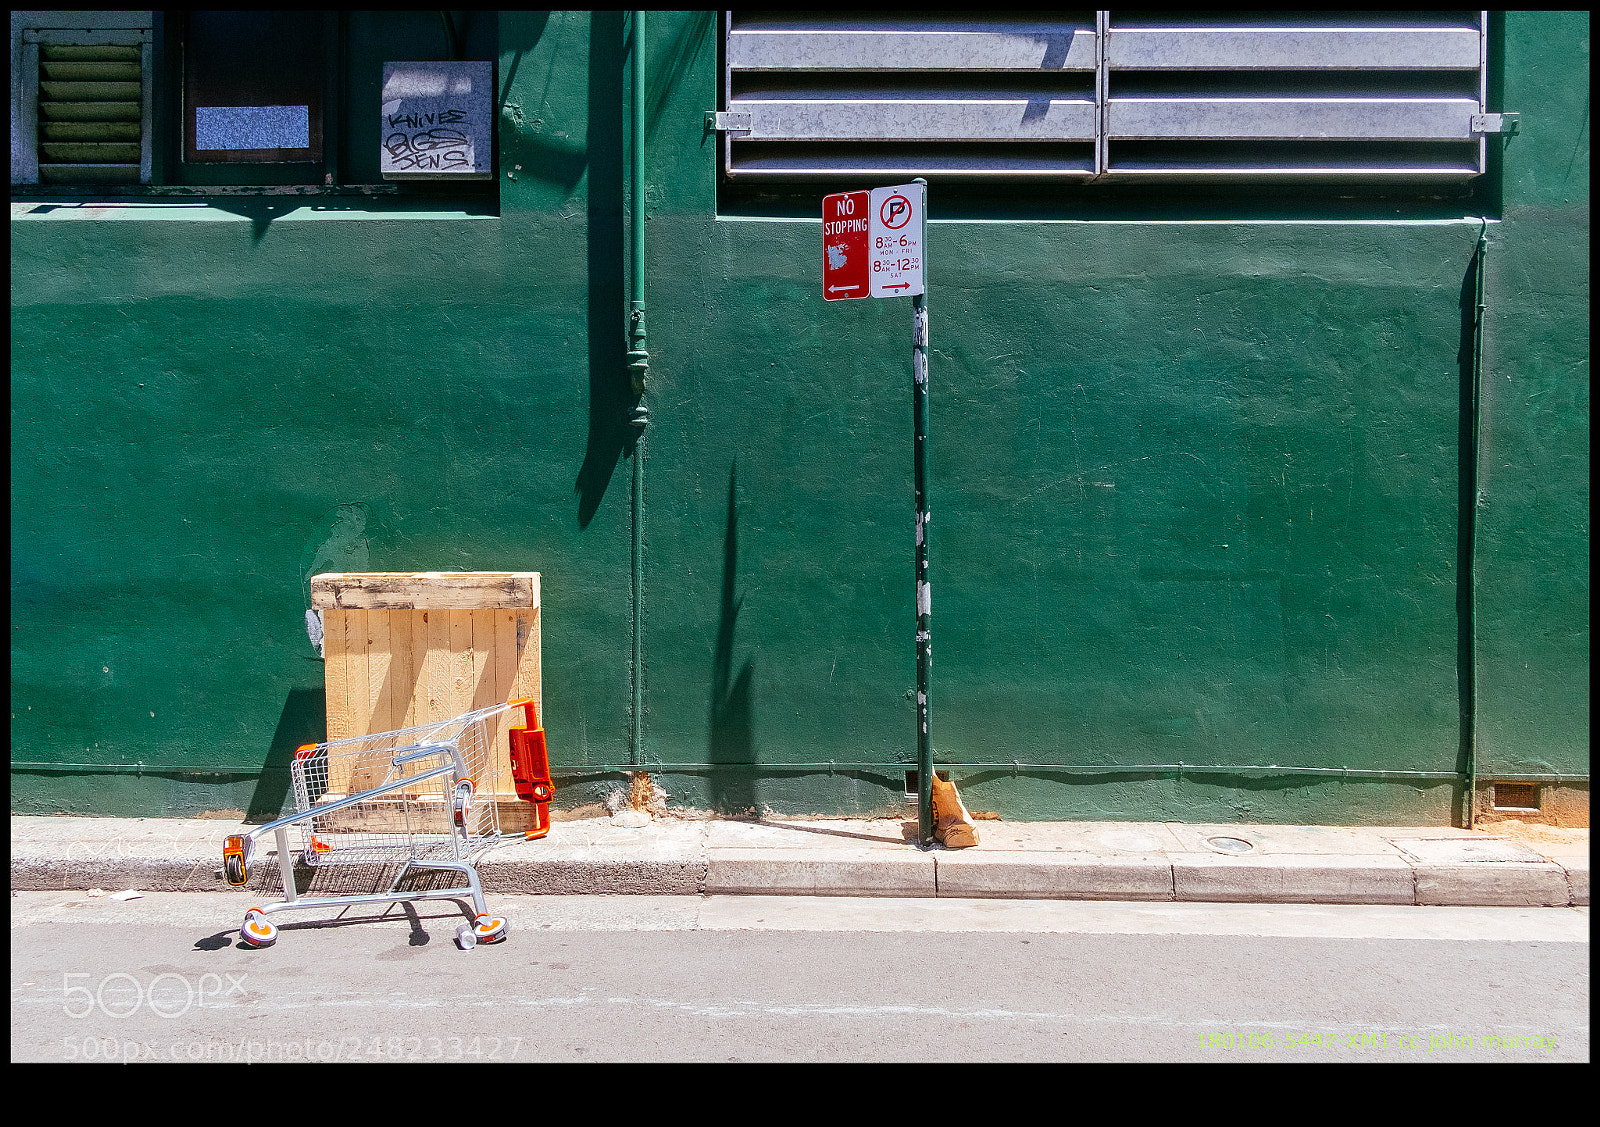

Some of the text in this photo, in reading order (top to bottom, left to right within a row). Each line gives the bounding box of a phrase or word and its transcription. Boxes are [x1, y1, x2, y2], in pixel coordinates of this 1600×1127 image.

[837, 199, 855, 217] NO
[889, 202, 906, 223] P
[825, 218, 868, 236] STOPPING
